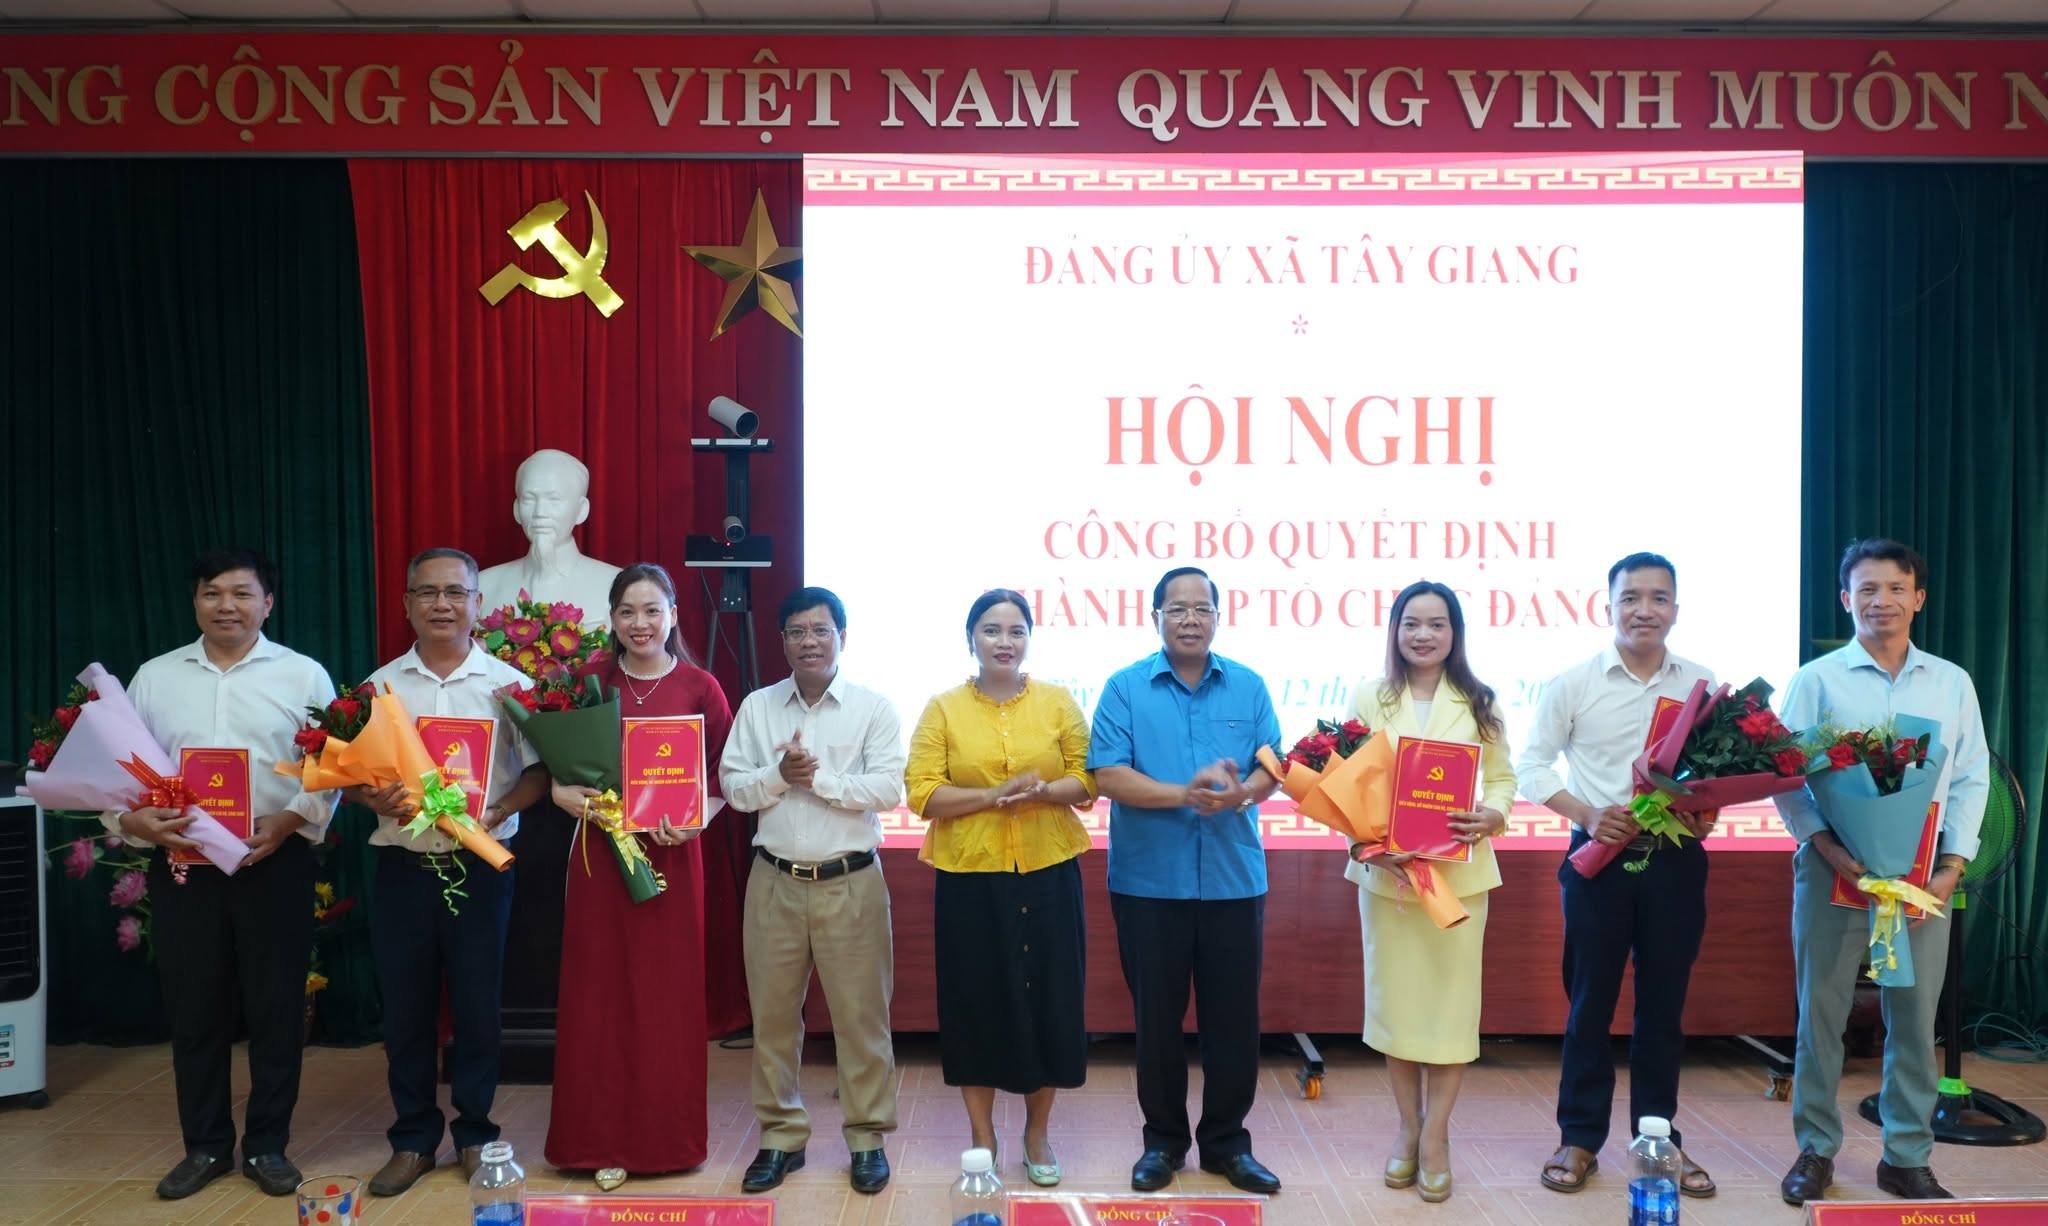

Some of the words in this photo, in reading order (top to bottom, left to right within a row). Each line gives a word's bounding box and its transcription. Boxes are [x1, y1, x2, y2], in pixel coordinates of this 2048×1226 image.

[155, 45, 406, 144] CỘNG
[427, 39, 608, 127] SẢN
[633, 48, 852, 145] VIỆT
[880, 67, 1081, 128] NAM
[1117, 67, 1430, 142] QUANG
[1447, 69, 1682, 130] VINH
[1709, 50, 1979, 131] MUÔN
[1245, 235, 1307, 284] XÃ
[1320, 233, 1414, 284] TÂY
[1427, 244, 1578, 285] GIANG
[1103, 383, 1255, 488] HỘI
[1284, 395, 1498, 488] NGHỊ
[1043, 508, 1176, 560] CÔNG
[1443, 520, 1557, 571] ĐỊNH
[659, 1208, 688, 1223] CHÍ
[1948, 1211, 1977, 1224] CHÍ
